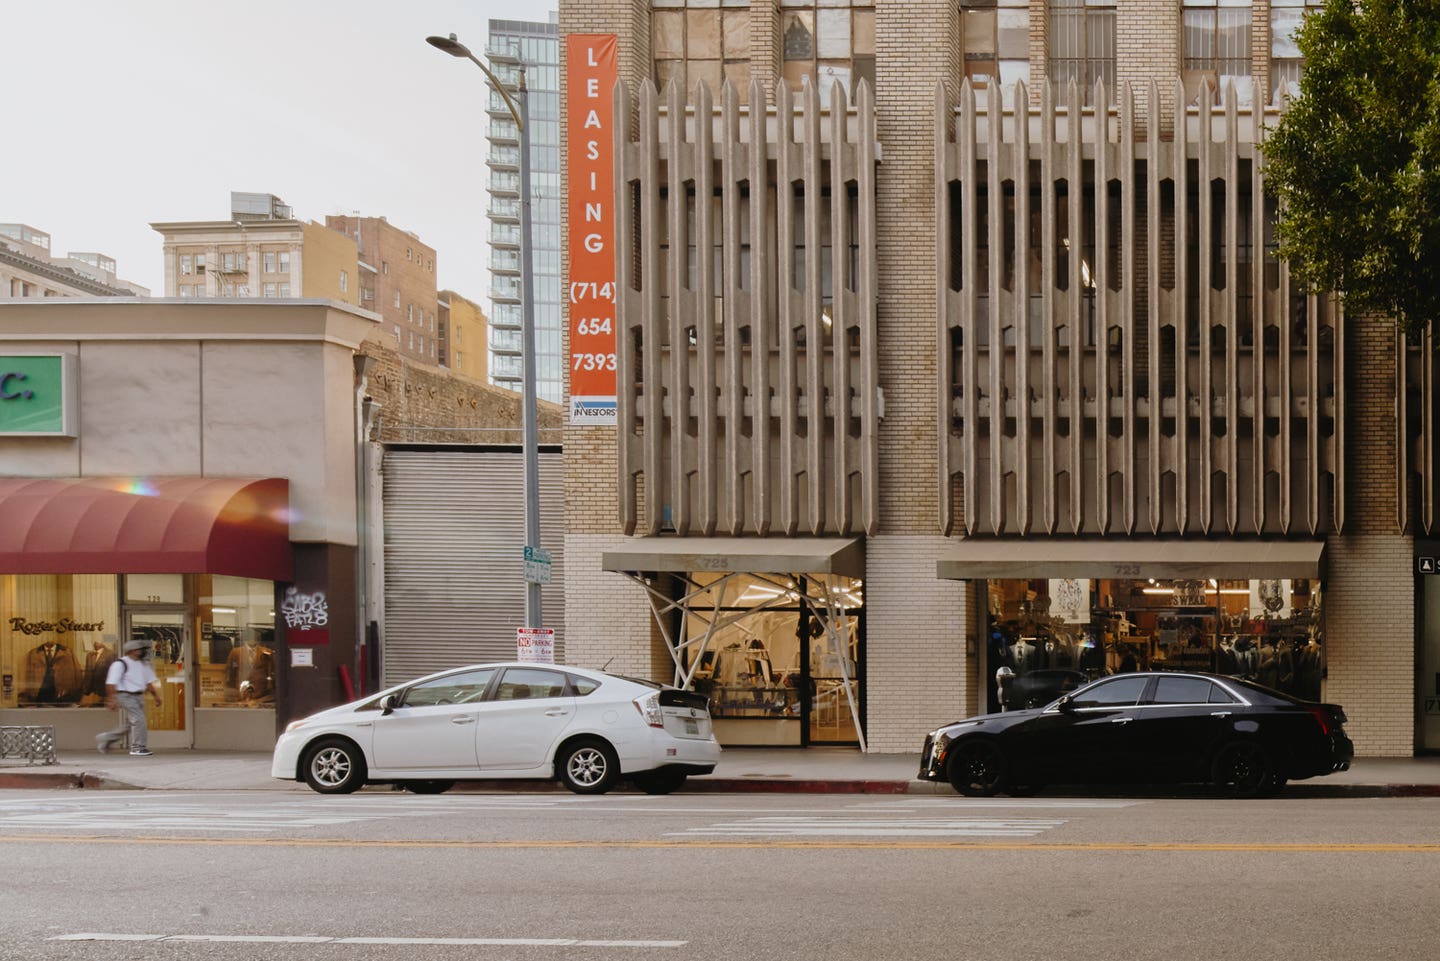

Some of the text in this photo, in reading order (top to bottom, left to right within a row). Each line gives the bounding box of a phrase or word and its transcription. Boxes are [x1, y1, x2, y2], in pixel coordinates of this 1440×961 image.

[584, 47, 604, 253] LEASING
[570, 282, 616, 303] (714)
[577, 318, 612, 335] 654
[572, 353, 616, 370] 7393
[574, 405, 616, 417] INVESTORS
[704, 557, 729, 569] 725
[1115, 564, 1141, 576] 723
[9, 617, 105, 636] Roger Stuart
[519, 638, 530, 647] NO
